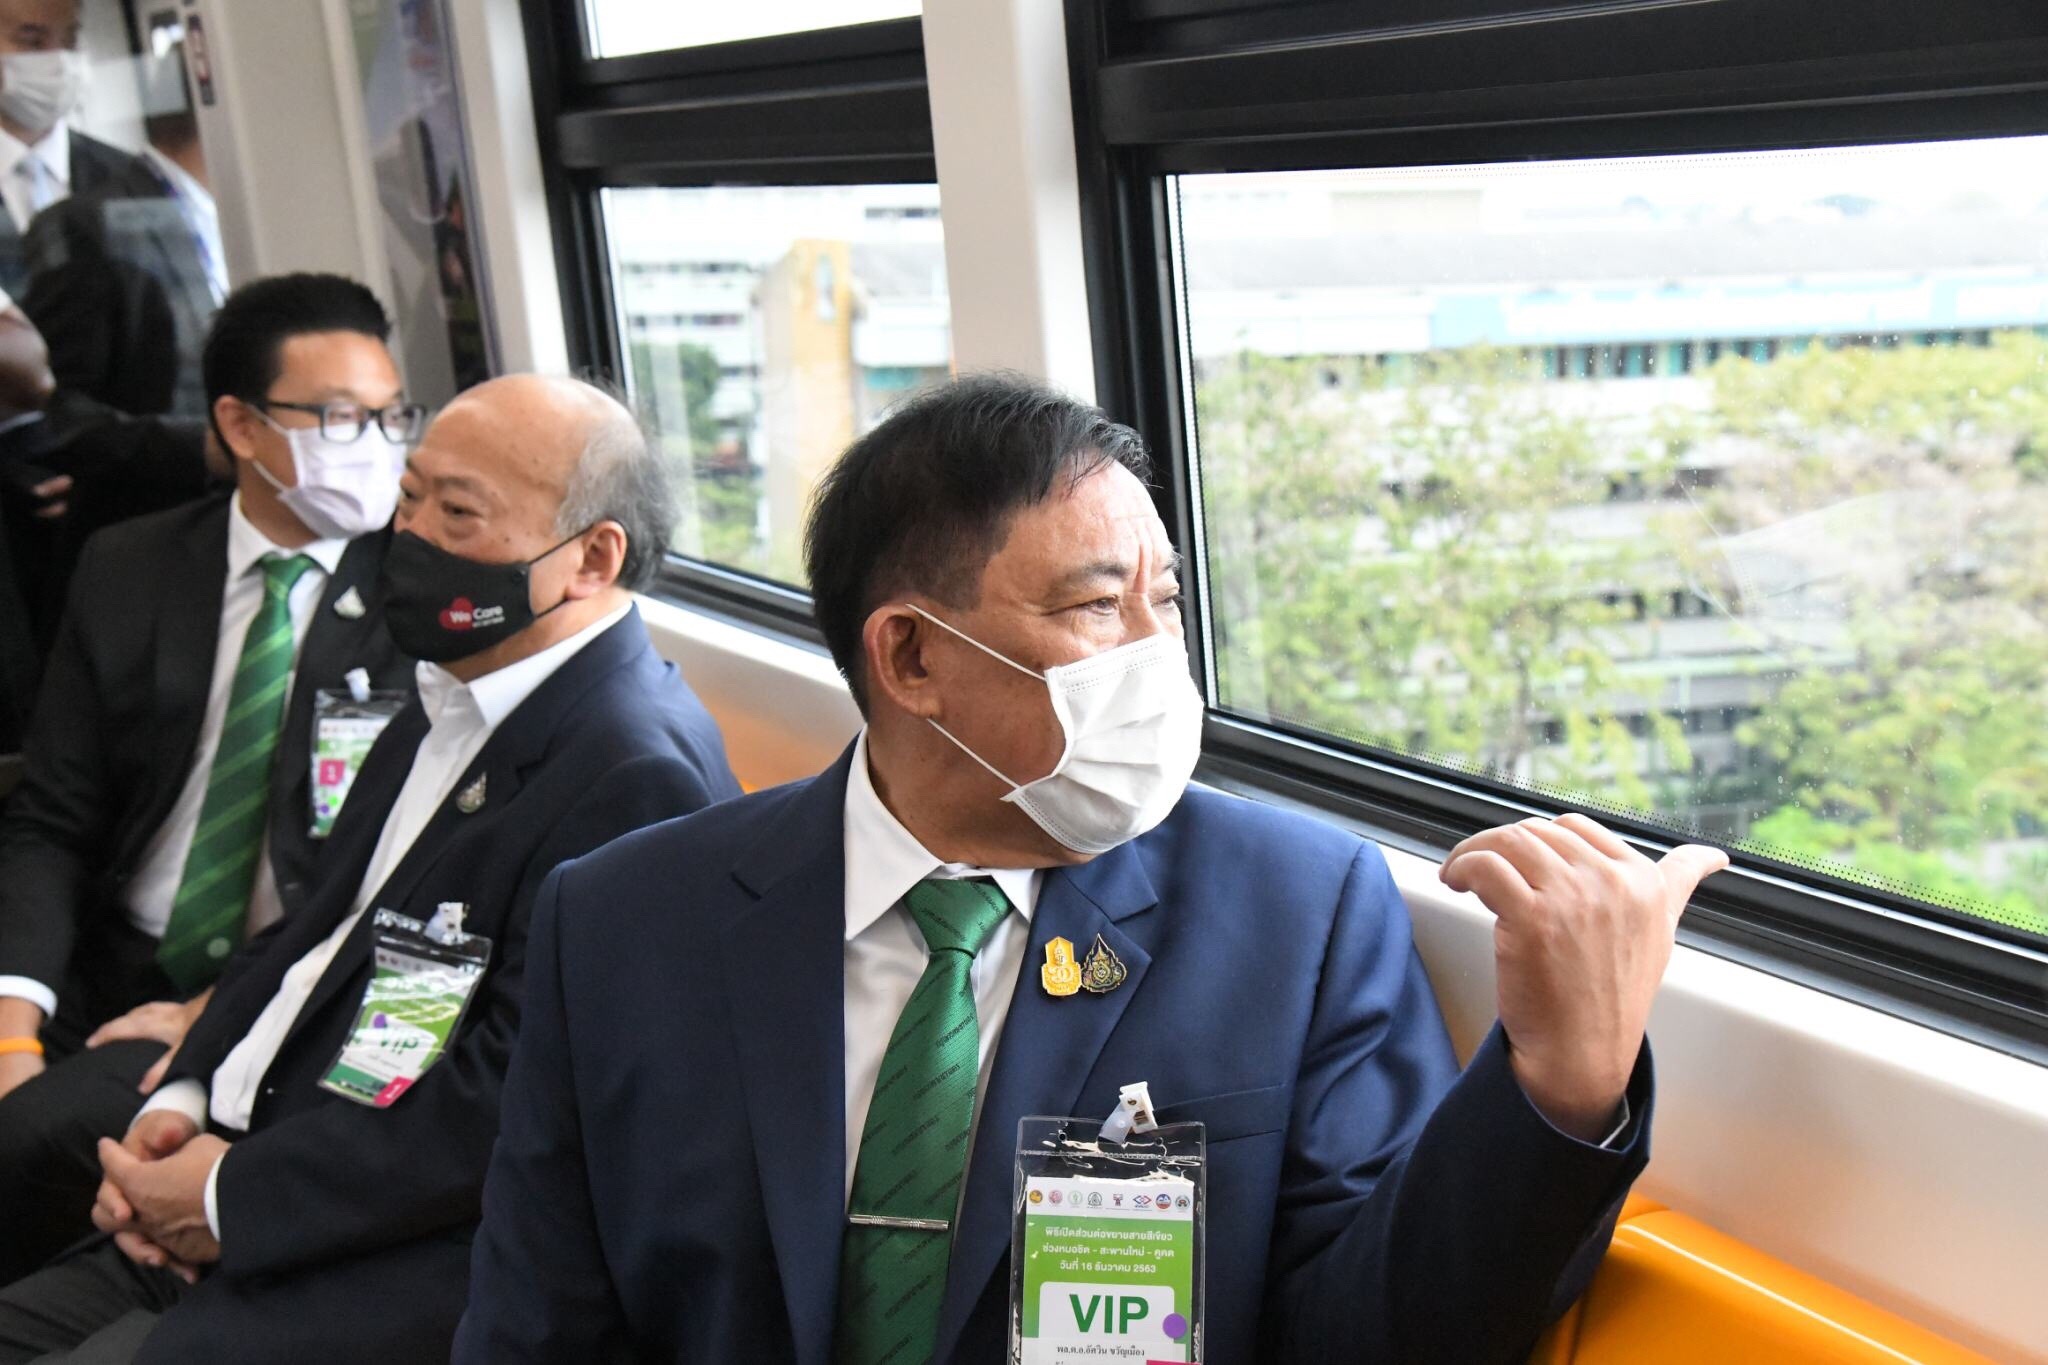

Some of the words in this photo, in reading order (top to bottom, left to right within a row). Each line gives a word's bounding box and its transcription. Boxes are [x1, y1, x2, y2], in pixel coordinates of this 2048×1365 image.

[449, 610, 472, 623] We
[472, 605, 504, 620] Care
[1042, 1242, 1090, 1254] ช่วงหมอชิต
[1100, 1245, 1145, 1256] สะพานใหม่
[1154, 1248, 1175, 1260] คูคต
[1060, 1257, 1079, 1270] วันที่
[1081, 1262, 1093, 1271] 16
[1094, 1261, 1131, 1273] ธันวาคม
[1133, 1264, 1156, 1273] 2563
[1069, 1294, 1149, 1334] VIP
